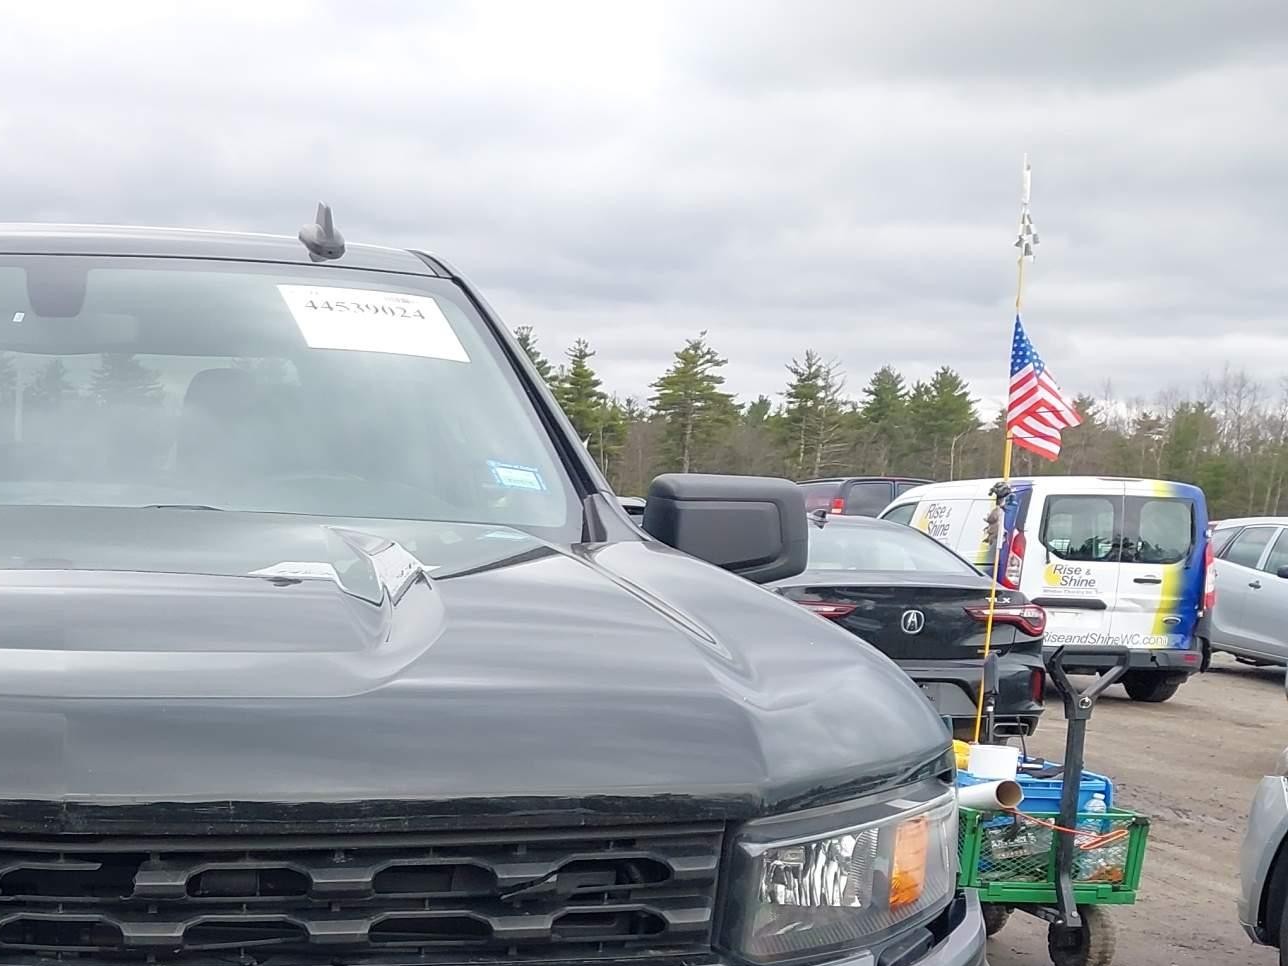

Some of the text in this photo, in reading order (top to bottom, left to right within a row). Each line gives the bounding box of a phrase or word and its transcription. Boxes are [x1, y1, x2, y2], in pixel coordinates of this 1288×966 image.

[304, 300, 425, 320] 44539024
[927, 520, 950, 537] Shine
[1053, 564, 1083, 575] Rise
[1060, 575, 1096, 587] Shine
